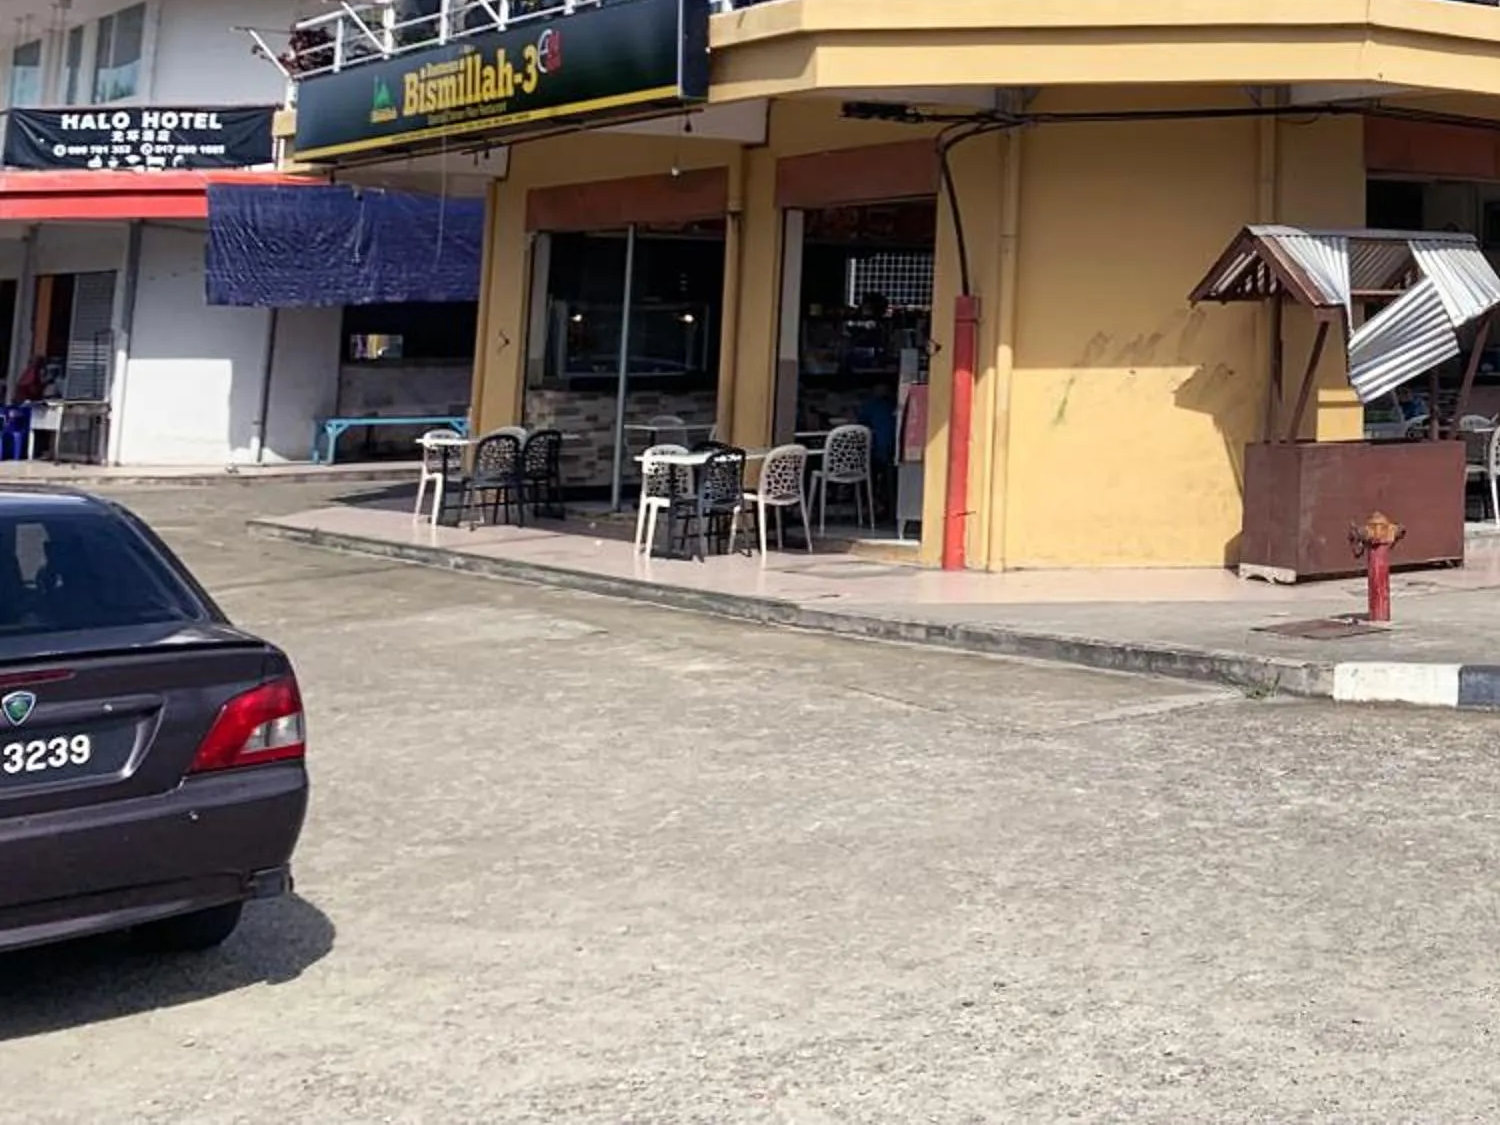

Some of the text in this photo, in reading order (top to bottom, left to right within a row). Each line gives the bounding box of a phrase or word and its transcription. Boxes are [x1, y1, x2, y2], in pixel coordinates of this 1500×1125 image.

[61, 111, 222, 130] HALO HOTEL
[3, 734, 91, 774] 3239
